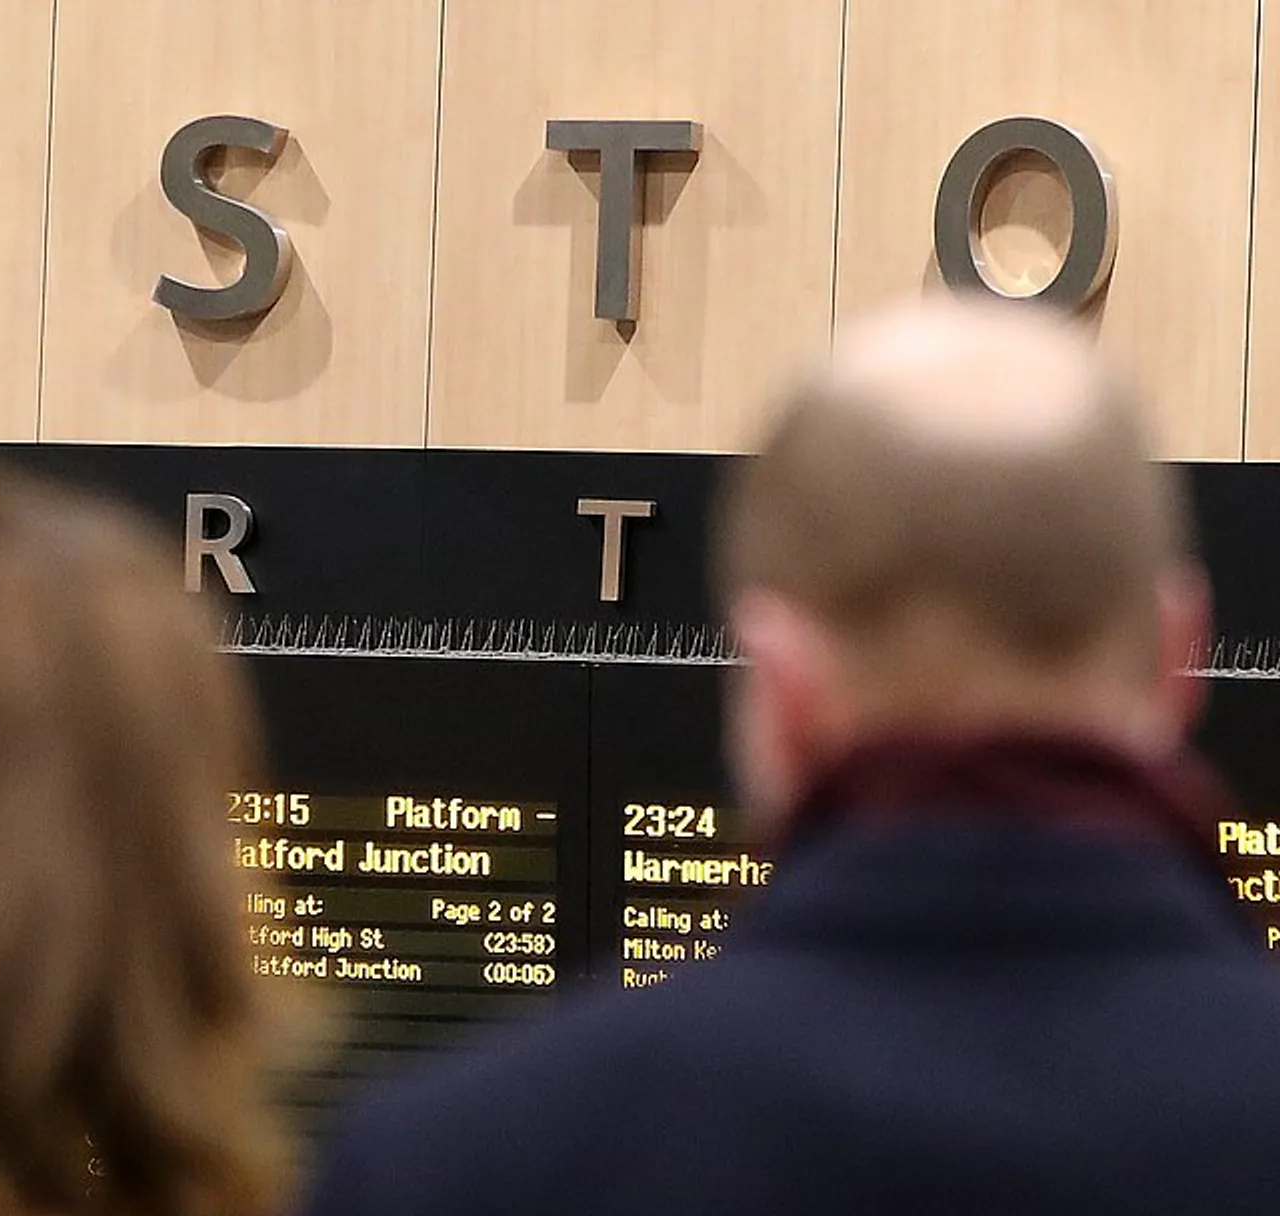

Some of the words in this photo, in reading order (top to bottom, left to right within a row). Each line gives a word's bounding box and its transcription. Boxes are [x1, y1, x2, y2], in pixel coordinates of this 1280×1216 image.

[227, 792, 310, 826] 23:15
[386, 796, 522, 832] Platform
[623, 804, 716, 838] 23:24
[358, 841, 491, 876] Junction
[294, 895, 324, 916] at:
[431, 898, 481, 925] Page
[488, 900, 501, 922] 2
[510, 901, 534, 922] of
[542, 902, 556, 923] 2
[623, 906, 691, 933] Calling
[699, 909, 730, 930] at:
[311, 926, 352, 953] High
[360, 928, 384, 950] St
[623, 938, 685, 960] Milton
[334, 959, 422, 981] Junction
